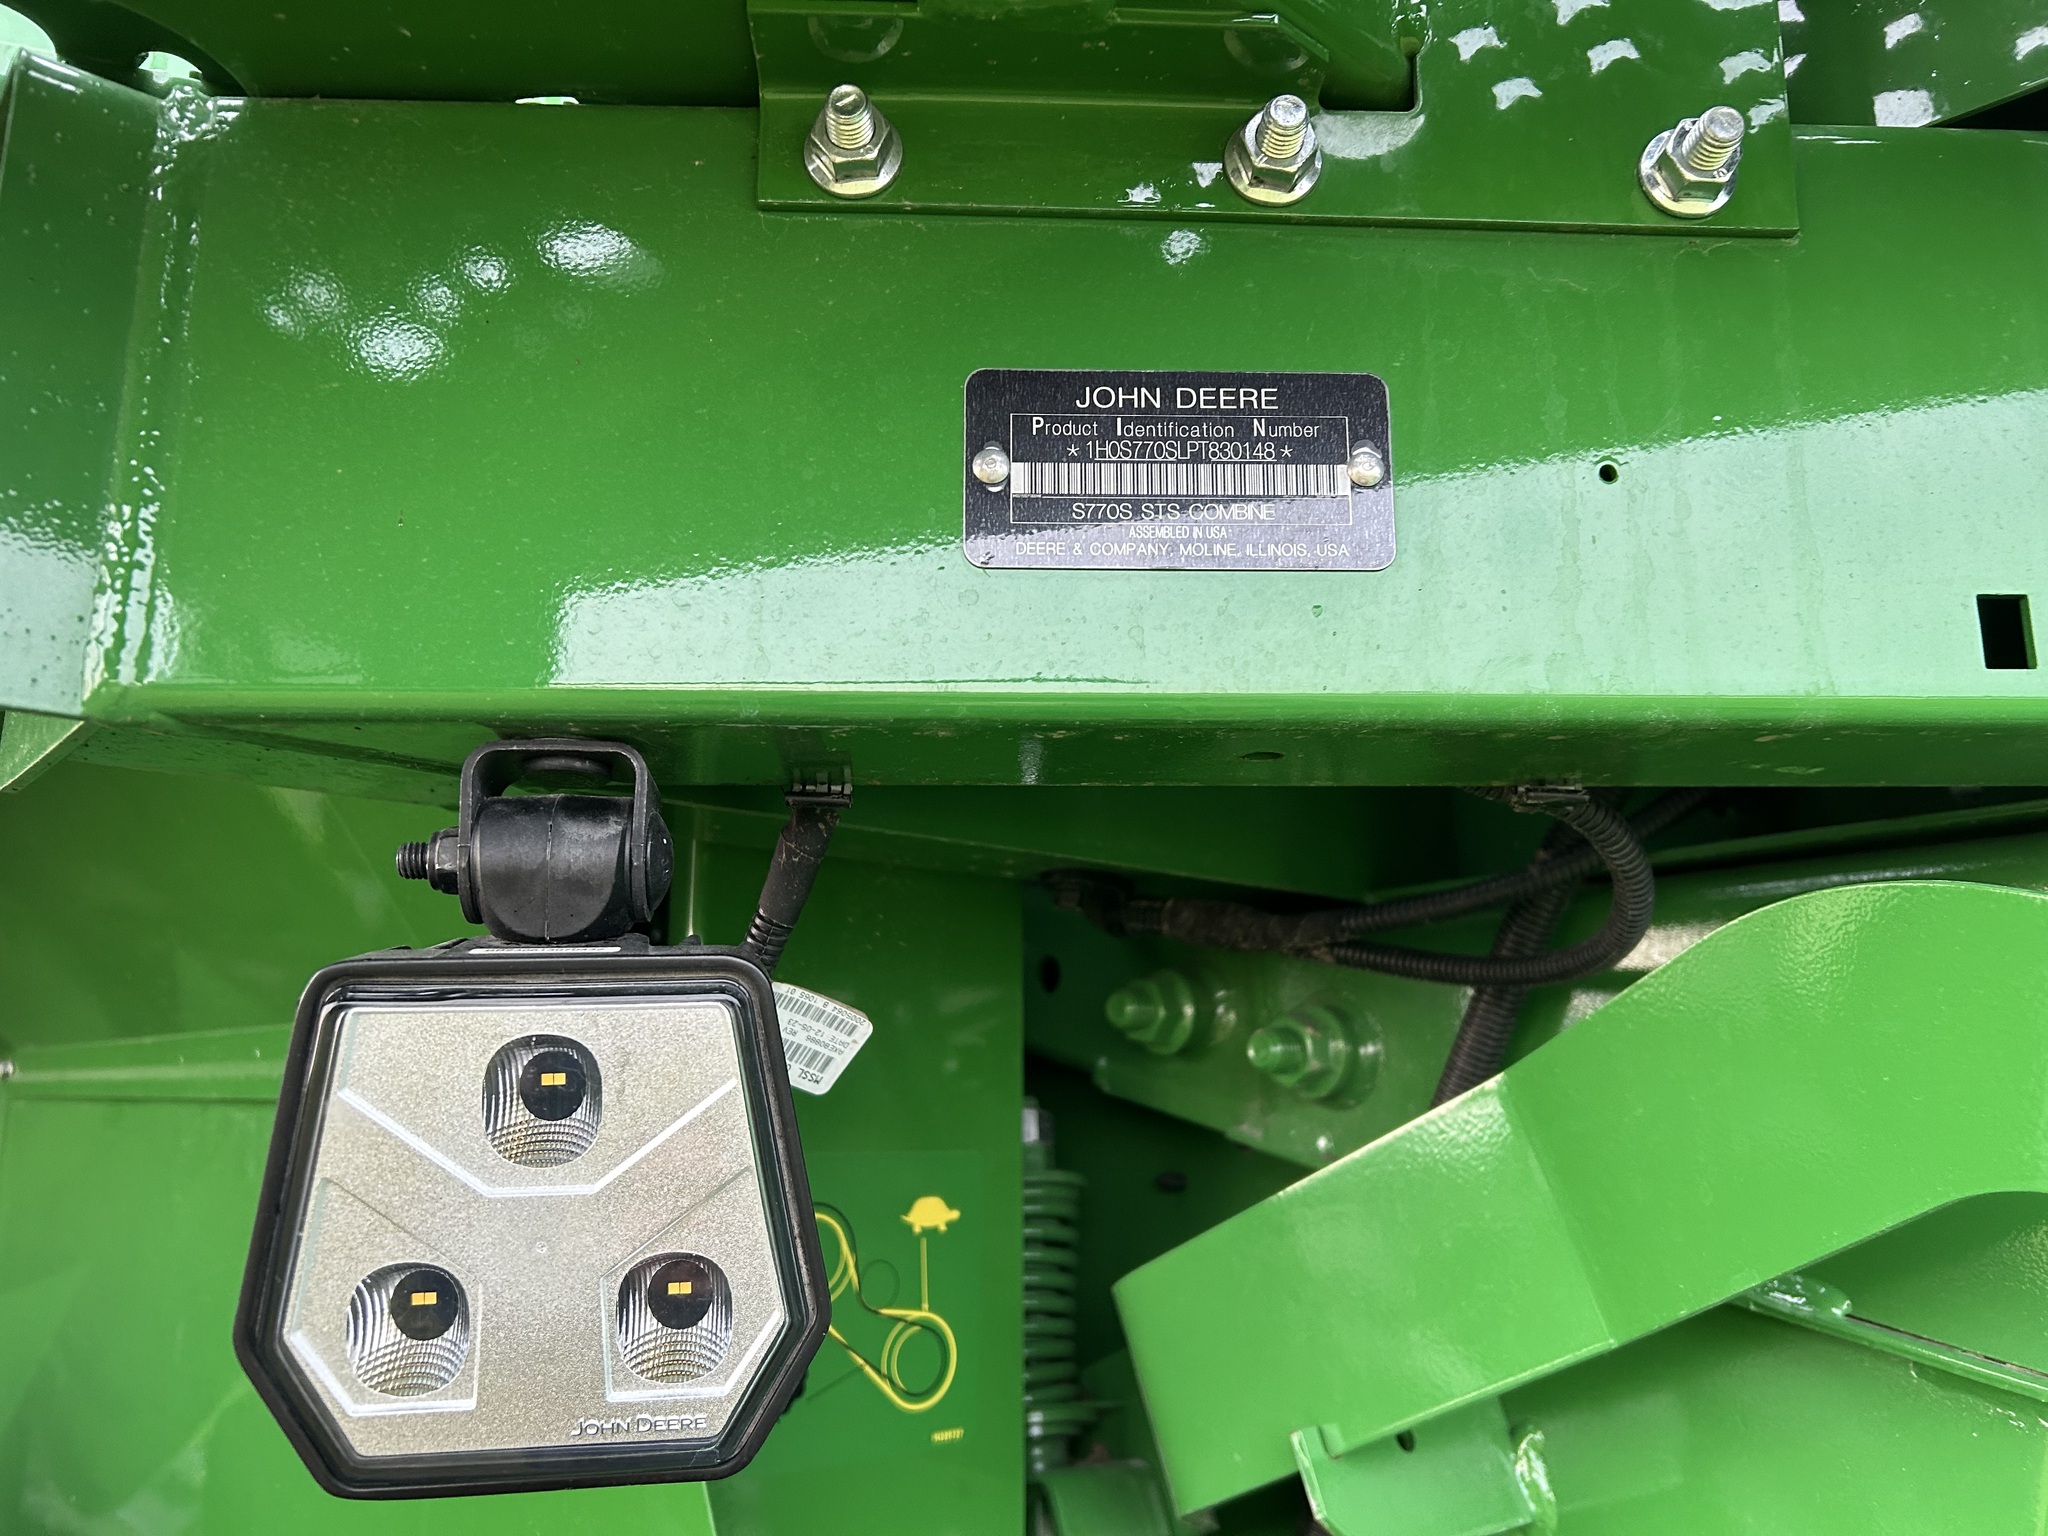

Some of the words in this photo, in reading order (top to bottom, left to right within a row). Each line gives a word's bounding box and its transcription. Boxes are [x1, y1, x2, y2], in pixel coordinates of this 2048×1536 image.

[1076, 386, 1161, 409] JOHN
[1176, 387, 1279, 410] DEERE
[1032, 416, 1099, 436] Product
[1116, 417, 1235, 437] Identification
[1253, 418, 1320, 438] Number
[1072, 502, 1132, 520] S770S
[1141, 503, 1180, 520] STS
[1188, 503, 1275, 521] COMBINE
[1129, 525, 1189, 539] ASSEMBLED
[1192, 526, 1203, 539] IN
[1206, 526, 1227, 539] USA
[1016, 541, 1066, 556] DEERE
[1072, 543, 1083, 556] &
[1089, 542, 1173, 559] COMPANY,
[1246, 543, 1310, 559] ILLINOIS,
[1317, 544, 1350, 557] USA
[782, 1026, 799, 1037] REV
[798, 1067, 824, 1085] MSSL
[570, 1417, 631, 1437] JOHN
[636, 1413, 708, 1433] DEERE
